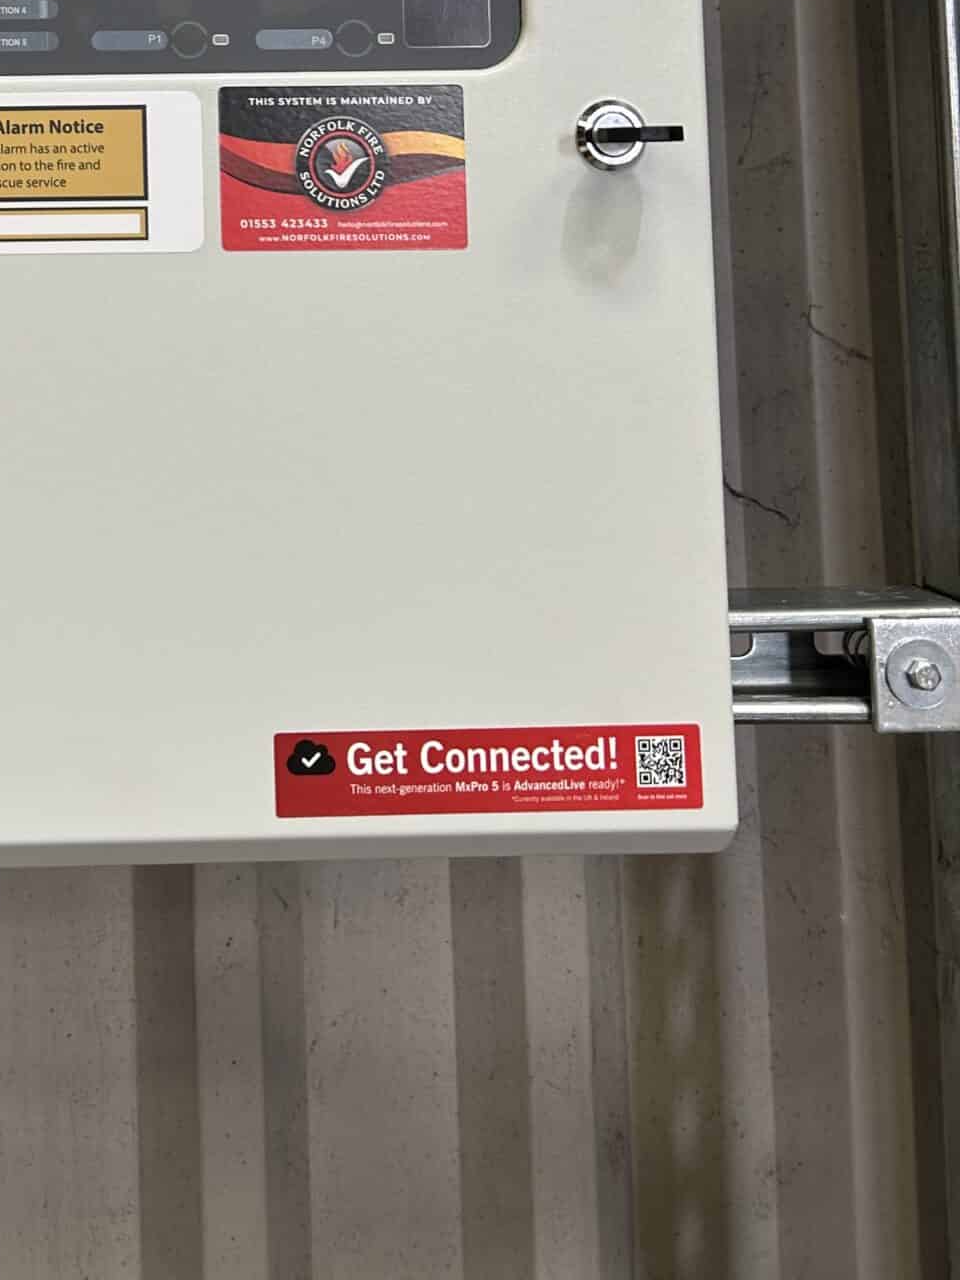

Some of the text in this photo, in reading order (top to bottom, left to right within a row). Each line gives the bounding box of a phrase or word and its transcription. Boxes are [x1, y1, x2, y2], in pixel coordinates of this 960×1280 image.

[19, 6, 28, 15] 4
[20, 38, 28, 48] 5
[147, 33, 162, 44] P1
[311, 35, 327, 47] P4
[248, 95, 433, 106] THIS SYSTEM IS MAINTAINED BY
[48, 118, 105, 135] Notice
[298, 119, 384, 158] NORFOLK FIRE
[30, 142, 50, 155] has
[52, 144, 67, 155] an
[69, 142, 105, 154] active
[18, 161, 32, 172] to
[34, 160, 54, 172] the
[56, 159, 77, 172] fire
[78, 159, 102, 171] and
[25, 176, 68, 189] service
[299, 169, 386, 210] SOLUTIONS LTD
[240, 218, 277, 230] 01553
[280, 218, 329, 229] 423433
[346, 736, 619, 777] Get Connected!
[349, 783, 373, 796] This
[374, 782, 454, 797] next-generation
[455, 780, 489, 793] MxPro
[491, 780, 500, 793] 5
[502, 780, 512, 792] is
[513, 779, 586, 792] AdvancedLive
